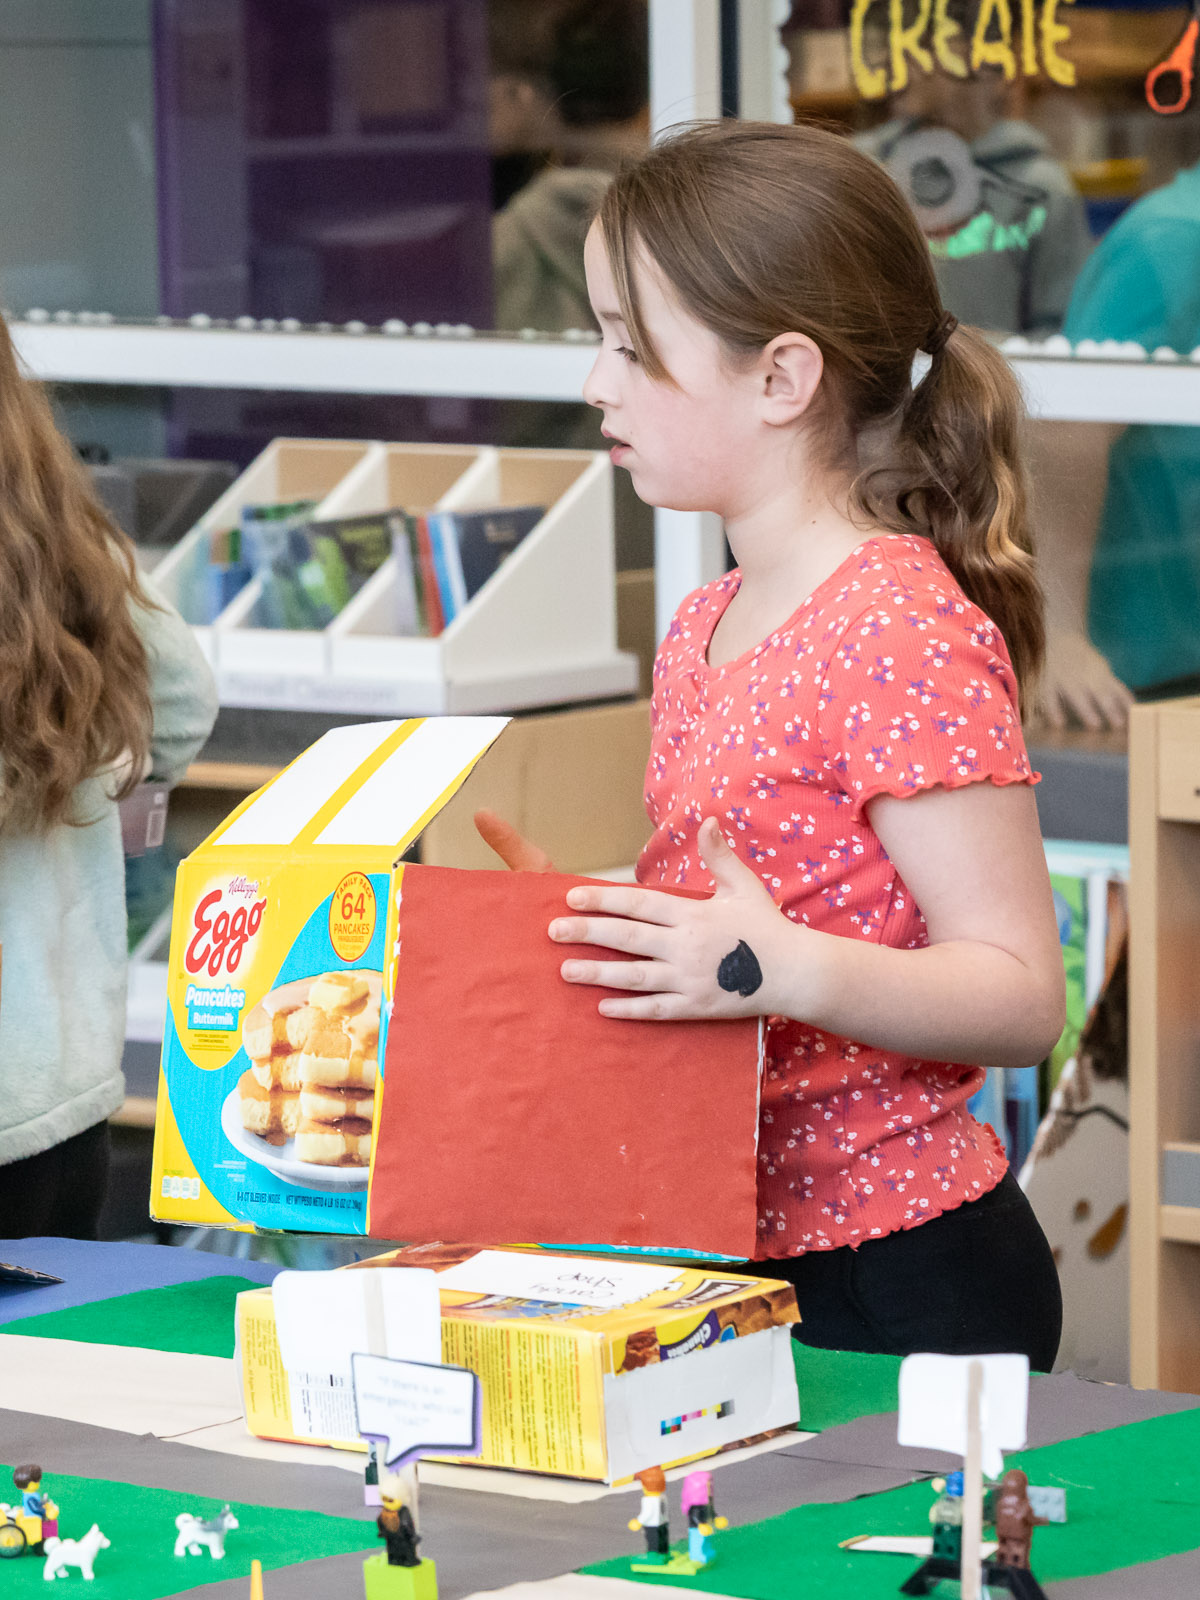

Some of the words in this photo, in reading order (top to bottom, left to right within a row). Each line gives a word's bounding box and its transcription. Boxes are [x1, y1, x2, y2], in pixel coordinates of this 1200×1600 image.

[336, 877, 358, 900] FAMILY
[360, 879, 373, 901] PACK
[341, 892, 366, 920] 64
[186, 889, 267, 977] Eggo
[333, 923, 370, 935] PANCAKES
[185, 985, 246, 1008] Pancakes
[193, 1012, 234, 1026] Buttermilk
